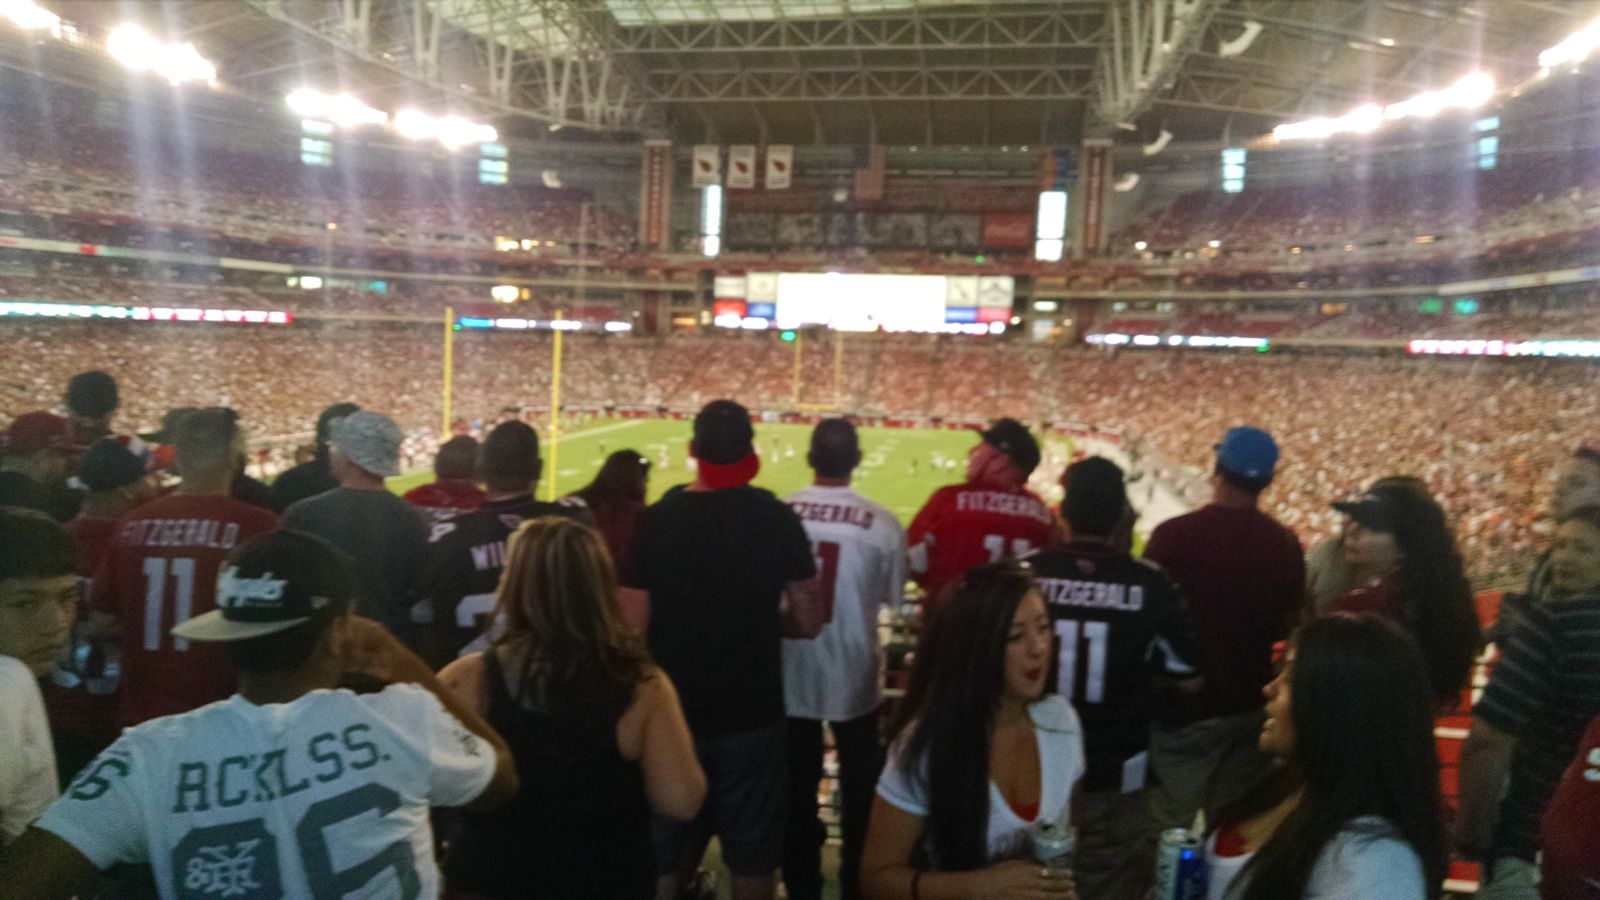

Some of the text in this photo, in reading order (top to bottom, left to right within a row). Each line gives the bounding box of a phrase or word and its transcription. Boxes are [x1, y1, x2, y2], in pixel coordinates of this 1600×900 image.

[121, 518, 239, 549] FITZGERALD
[143, 557, 196, 650] 11
[1055, 618, 1109, 704] 11
